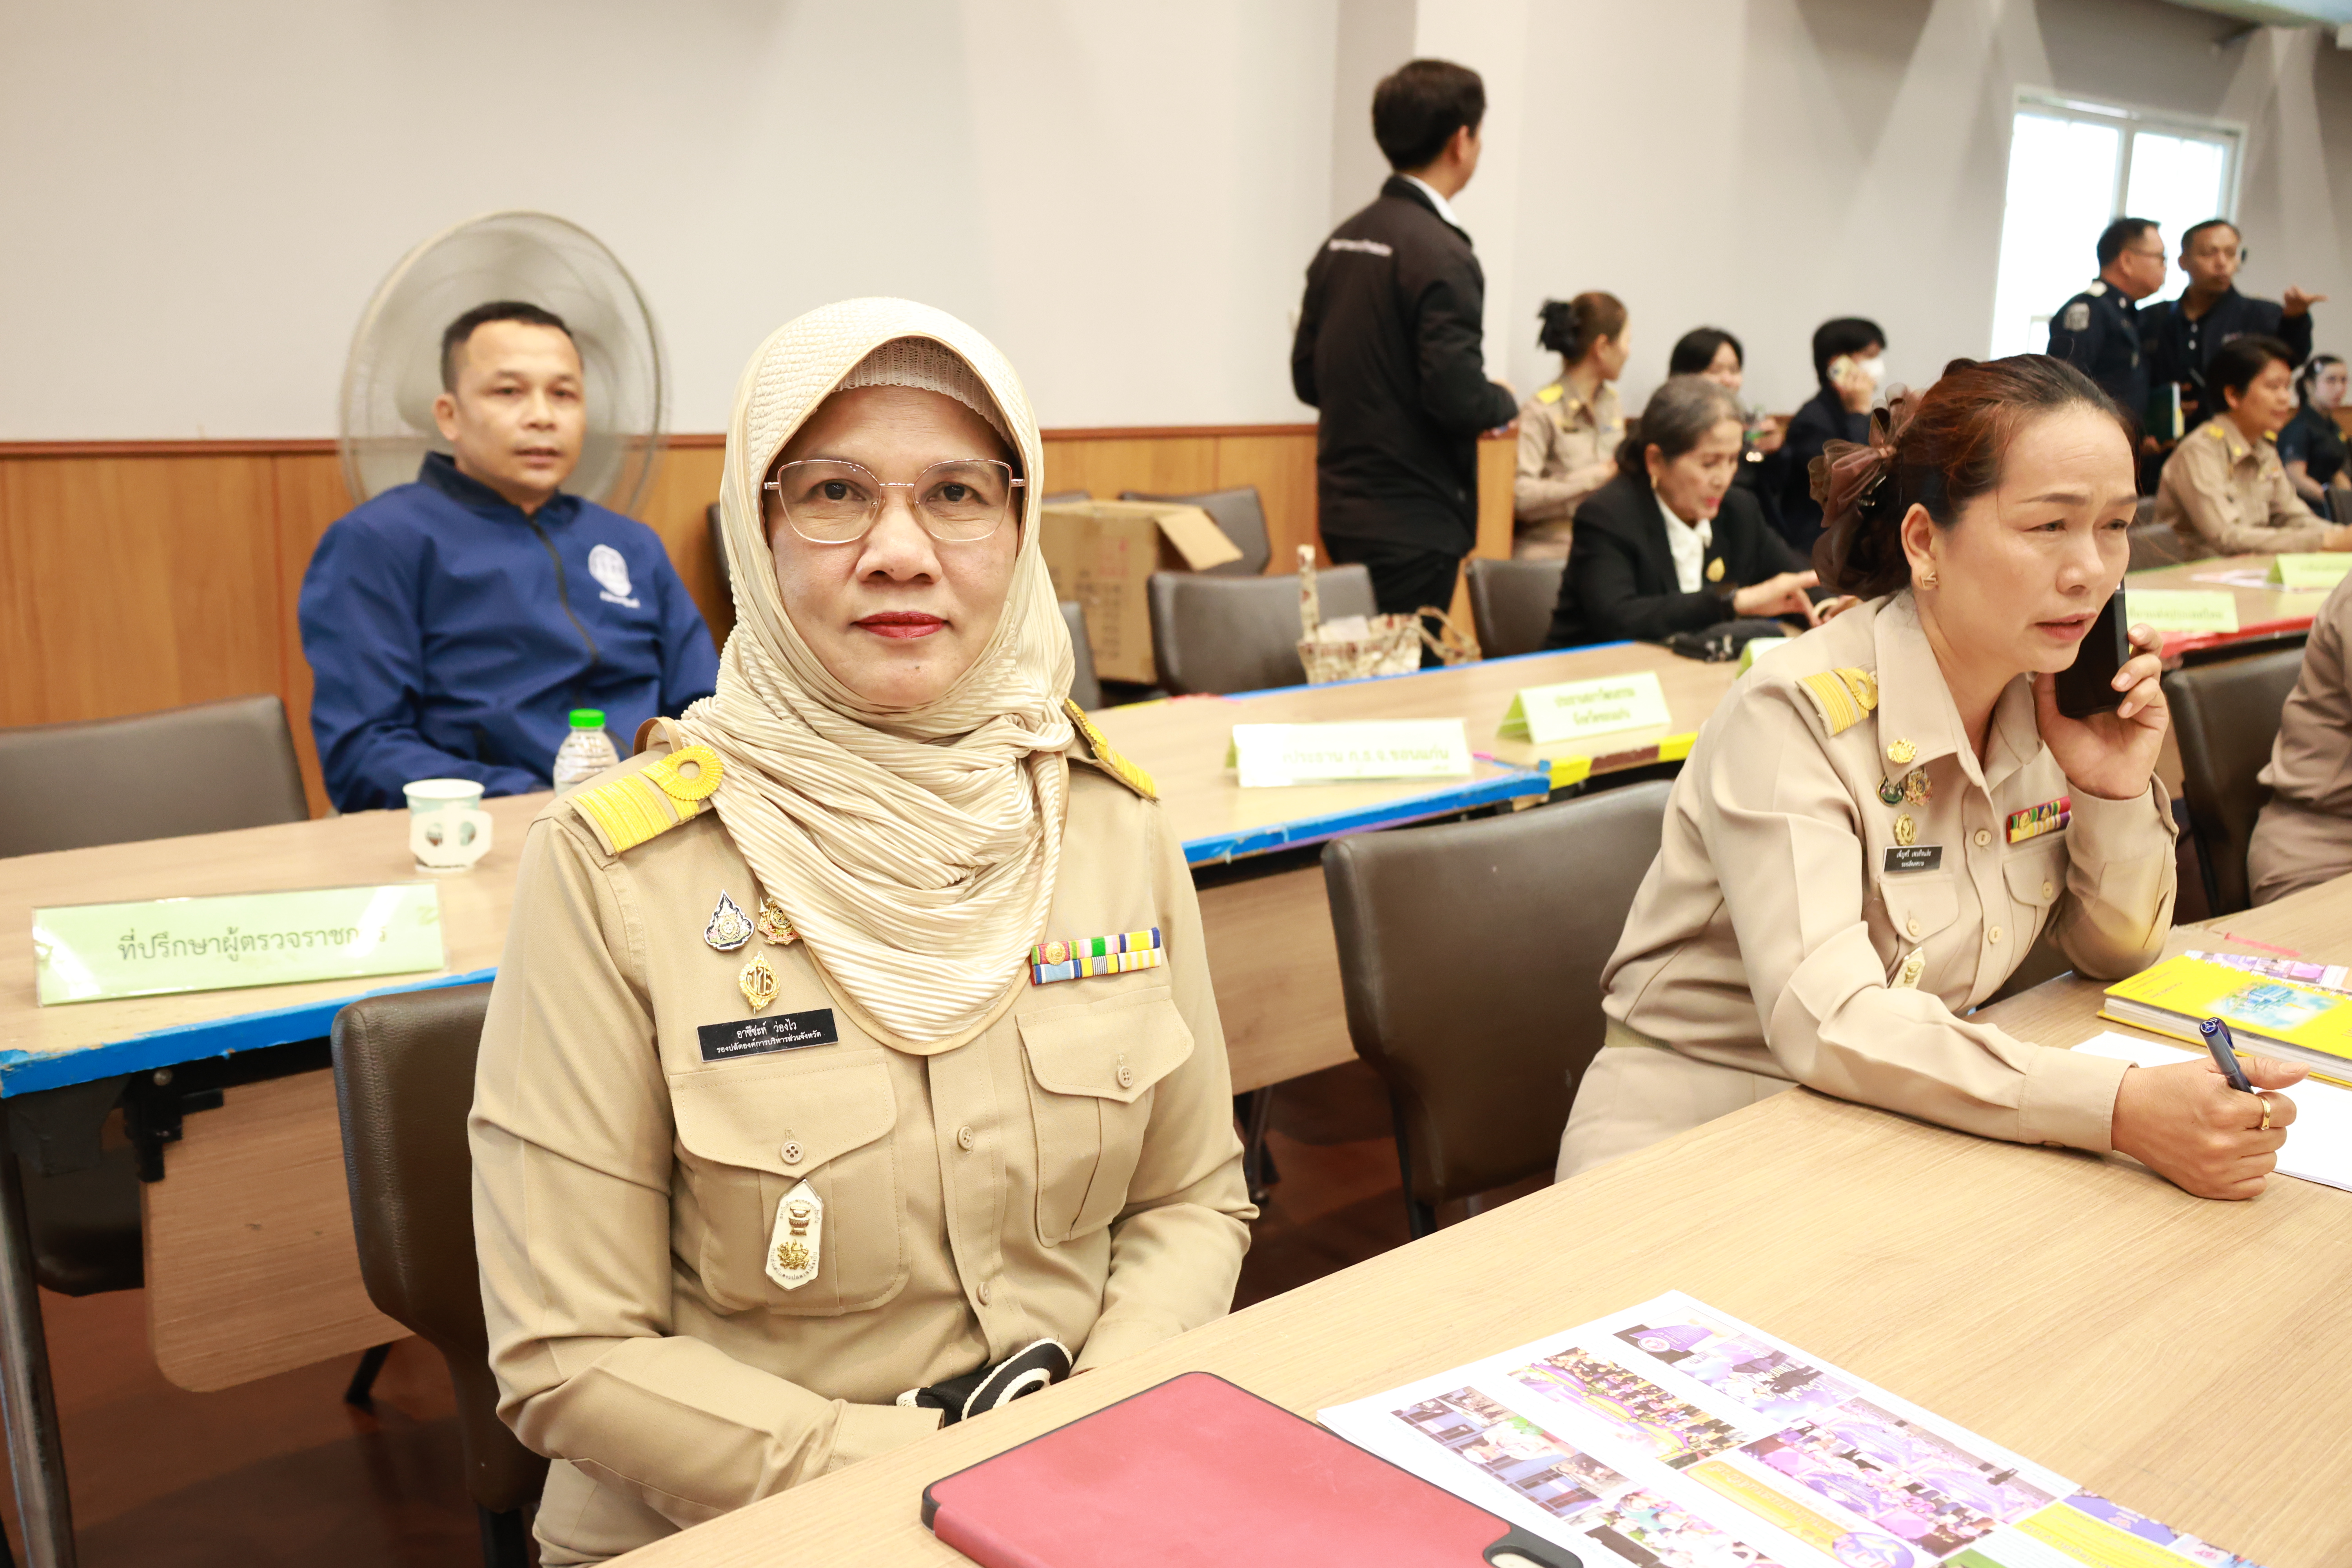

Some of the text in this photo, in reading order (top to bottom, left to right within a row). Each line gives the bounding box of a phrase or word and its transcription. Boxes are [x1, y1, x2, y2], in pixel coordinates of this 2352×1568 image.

[118, 927, 387, 962] ที่ปรึกษาผู้ตรวจราชกร
[774, 1018, 797, 1033] ว่องไว
[717, 1031, 821, 1053] รองปลัดองค์การบริหารส่วนจังหวัด
